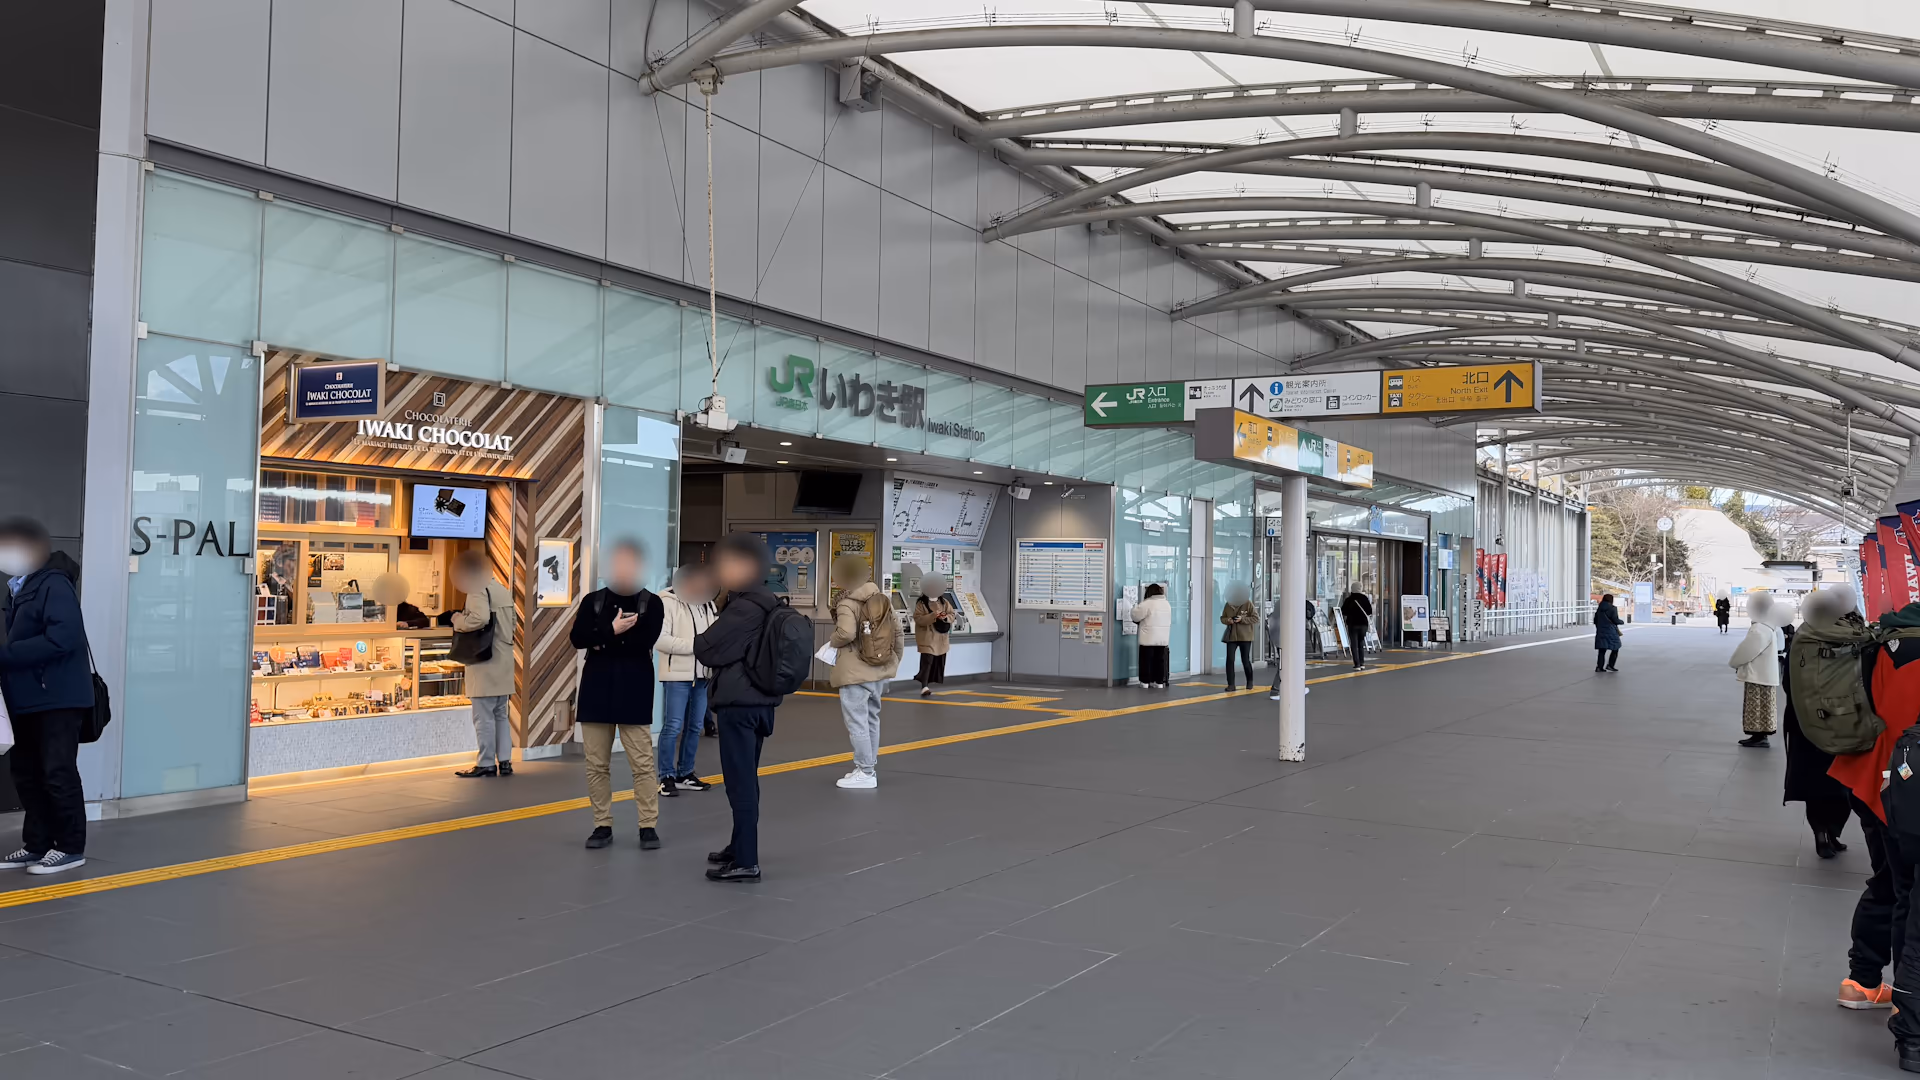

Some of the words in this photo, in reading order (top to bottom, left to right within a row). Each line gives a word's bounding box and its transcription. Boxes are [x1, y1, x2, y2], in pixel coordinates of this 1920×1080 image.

[770, 354, 814, 398] JR
[1462, 372, 1489, 384] 北口
[1286, 380, 1327, 388] 観光案内所
[307, 391, 328, 400] IWAKI
[330, 389, 372, 399] CHOCOLAT
[1126, 388, 1145, 400] JR
[1148, 386, 1167, 397] 入口
[1408, 392, 1434, 401] タクシー
[820, 368, 925, 430] いわき駅
[405, 410, 472, 426] CHOCOLATERIE
[357, 420, 414, 440] IWAKI
[418, 426, 512, 451] CHOCOLAT
[928, 418, 952, 436] Iwaki
[953, 423, 986, 442] Station
[131, 516, 250, 557] S-PAL
